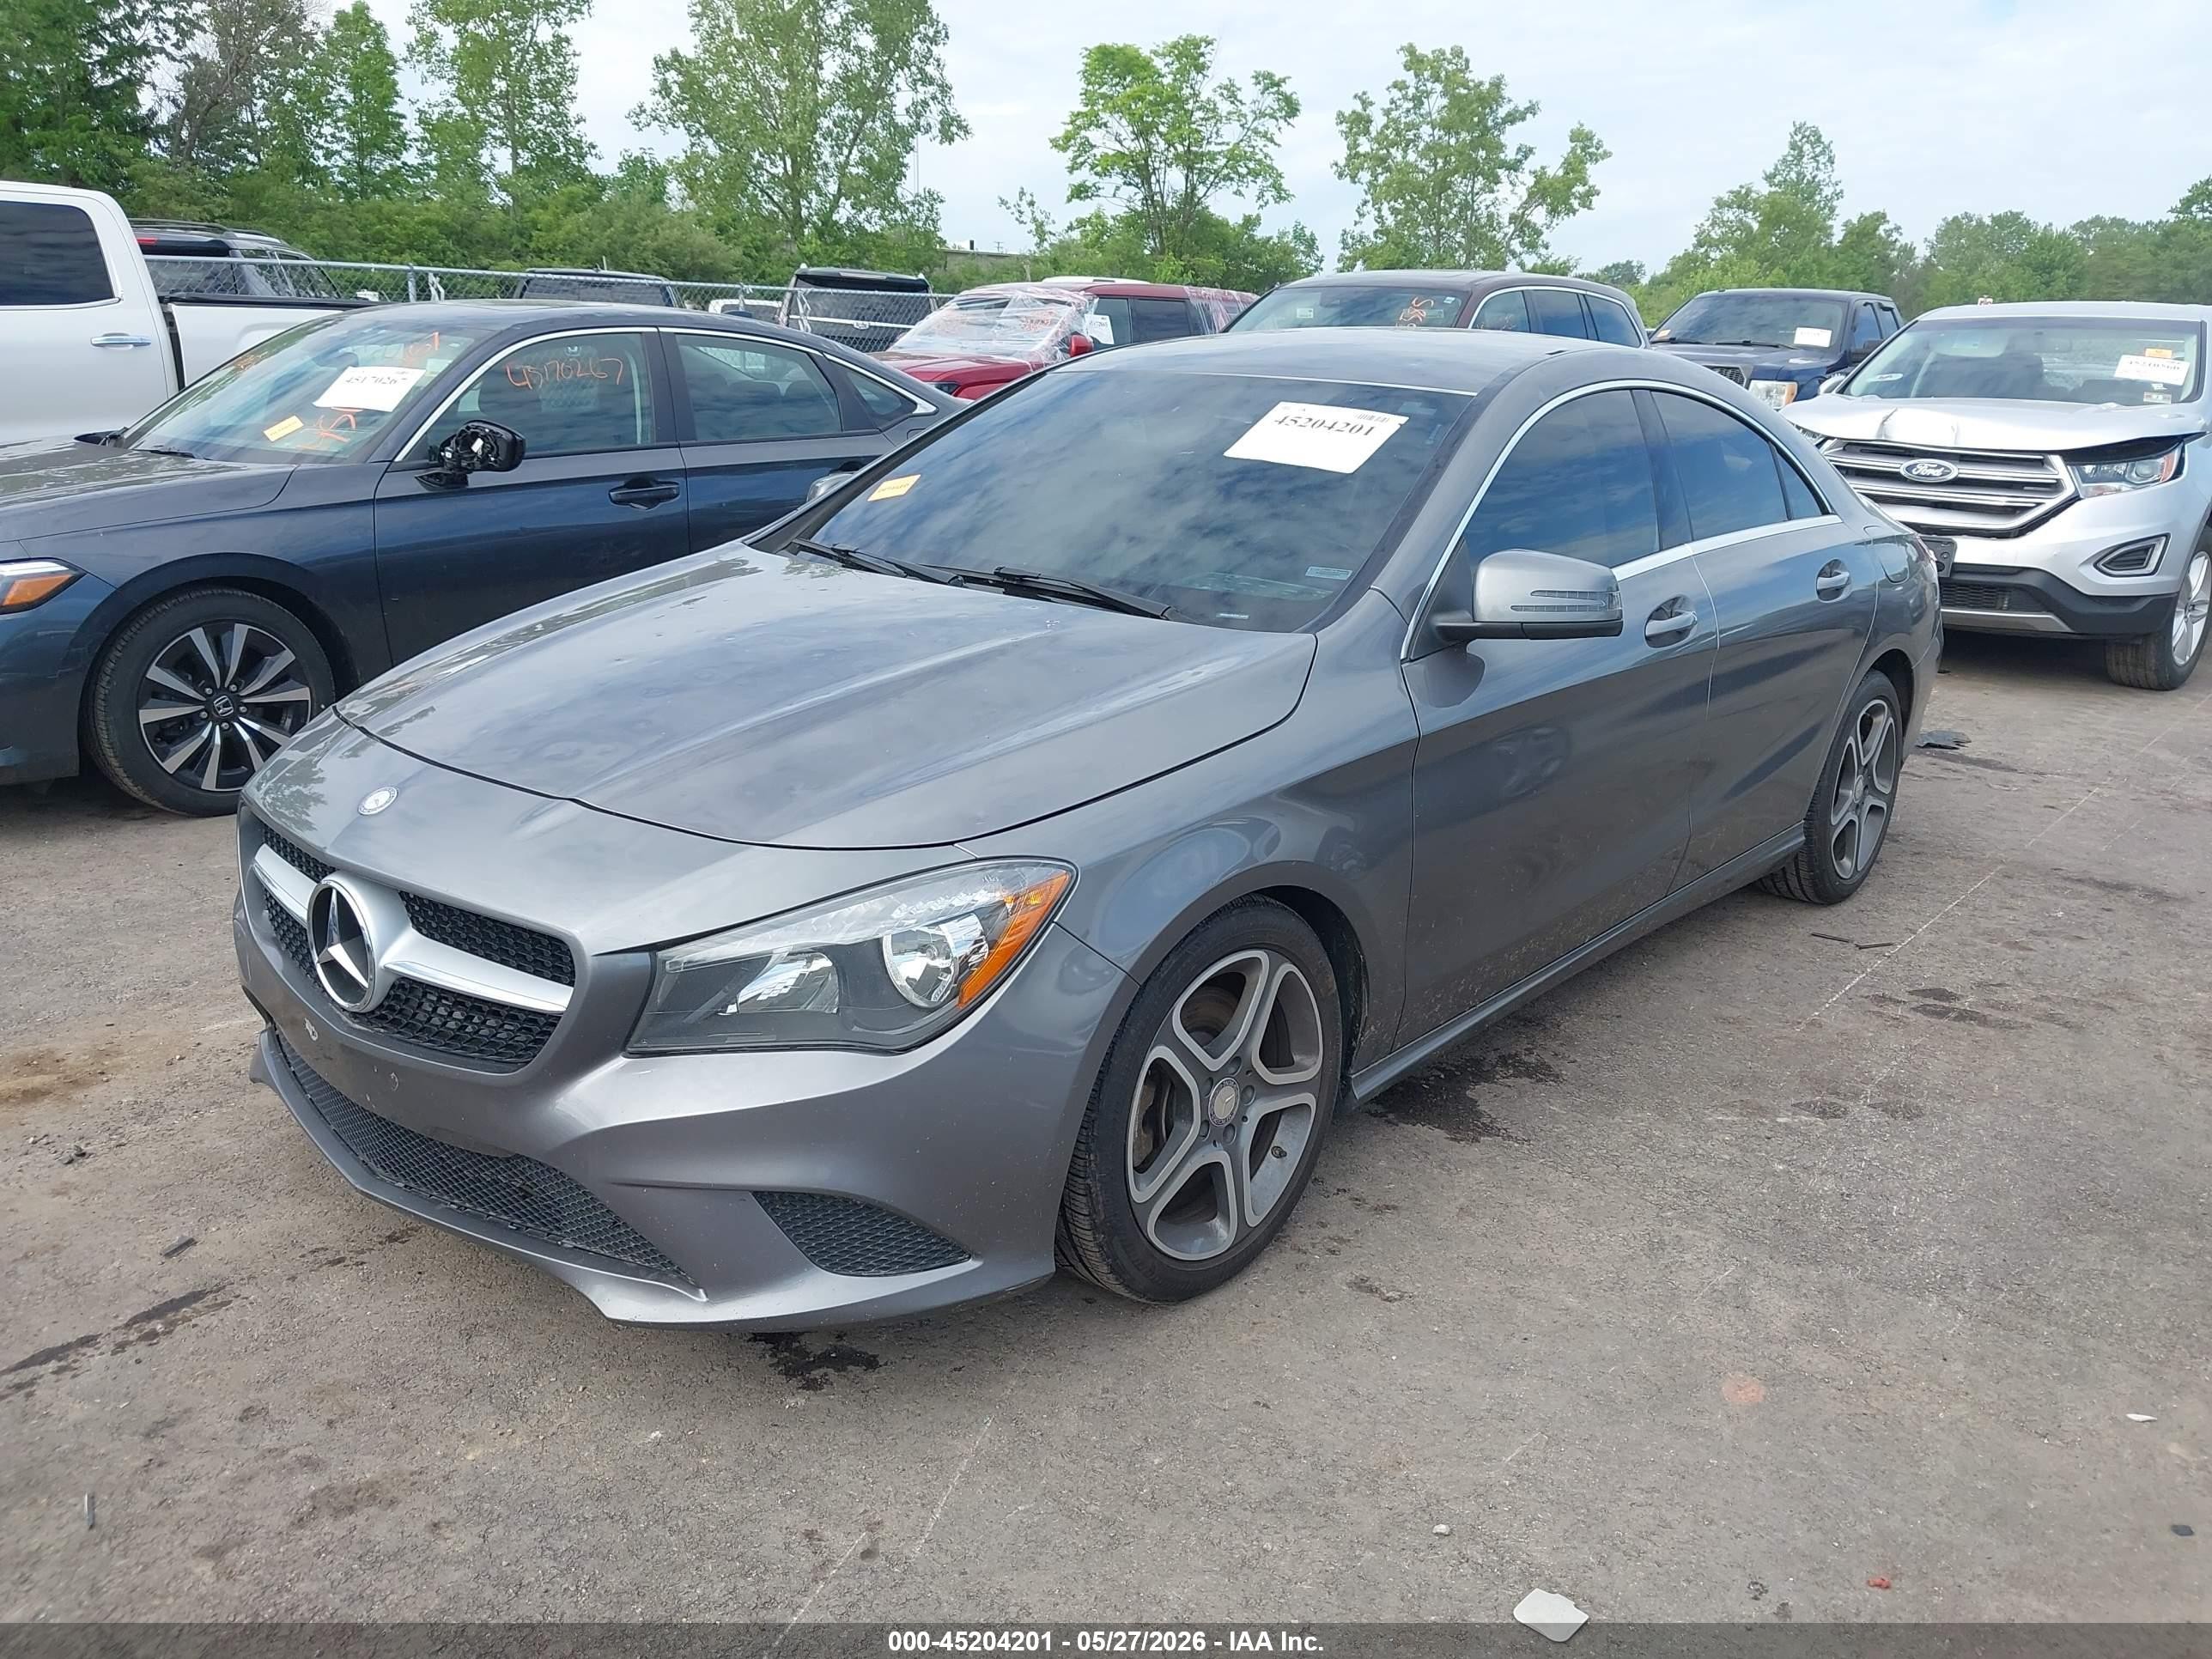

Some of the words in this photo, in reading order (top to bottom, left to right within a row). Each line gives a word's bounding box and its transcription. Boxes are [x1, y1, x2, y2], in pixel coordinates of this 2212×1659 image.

[507, 357, 623, 390] 45170267
[1274, 416, 1376, 435] 45204201
[1911, 463, 1945, 477] Ford
